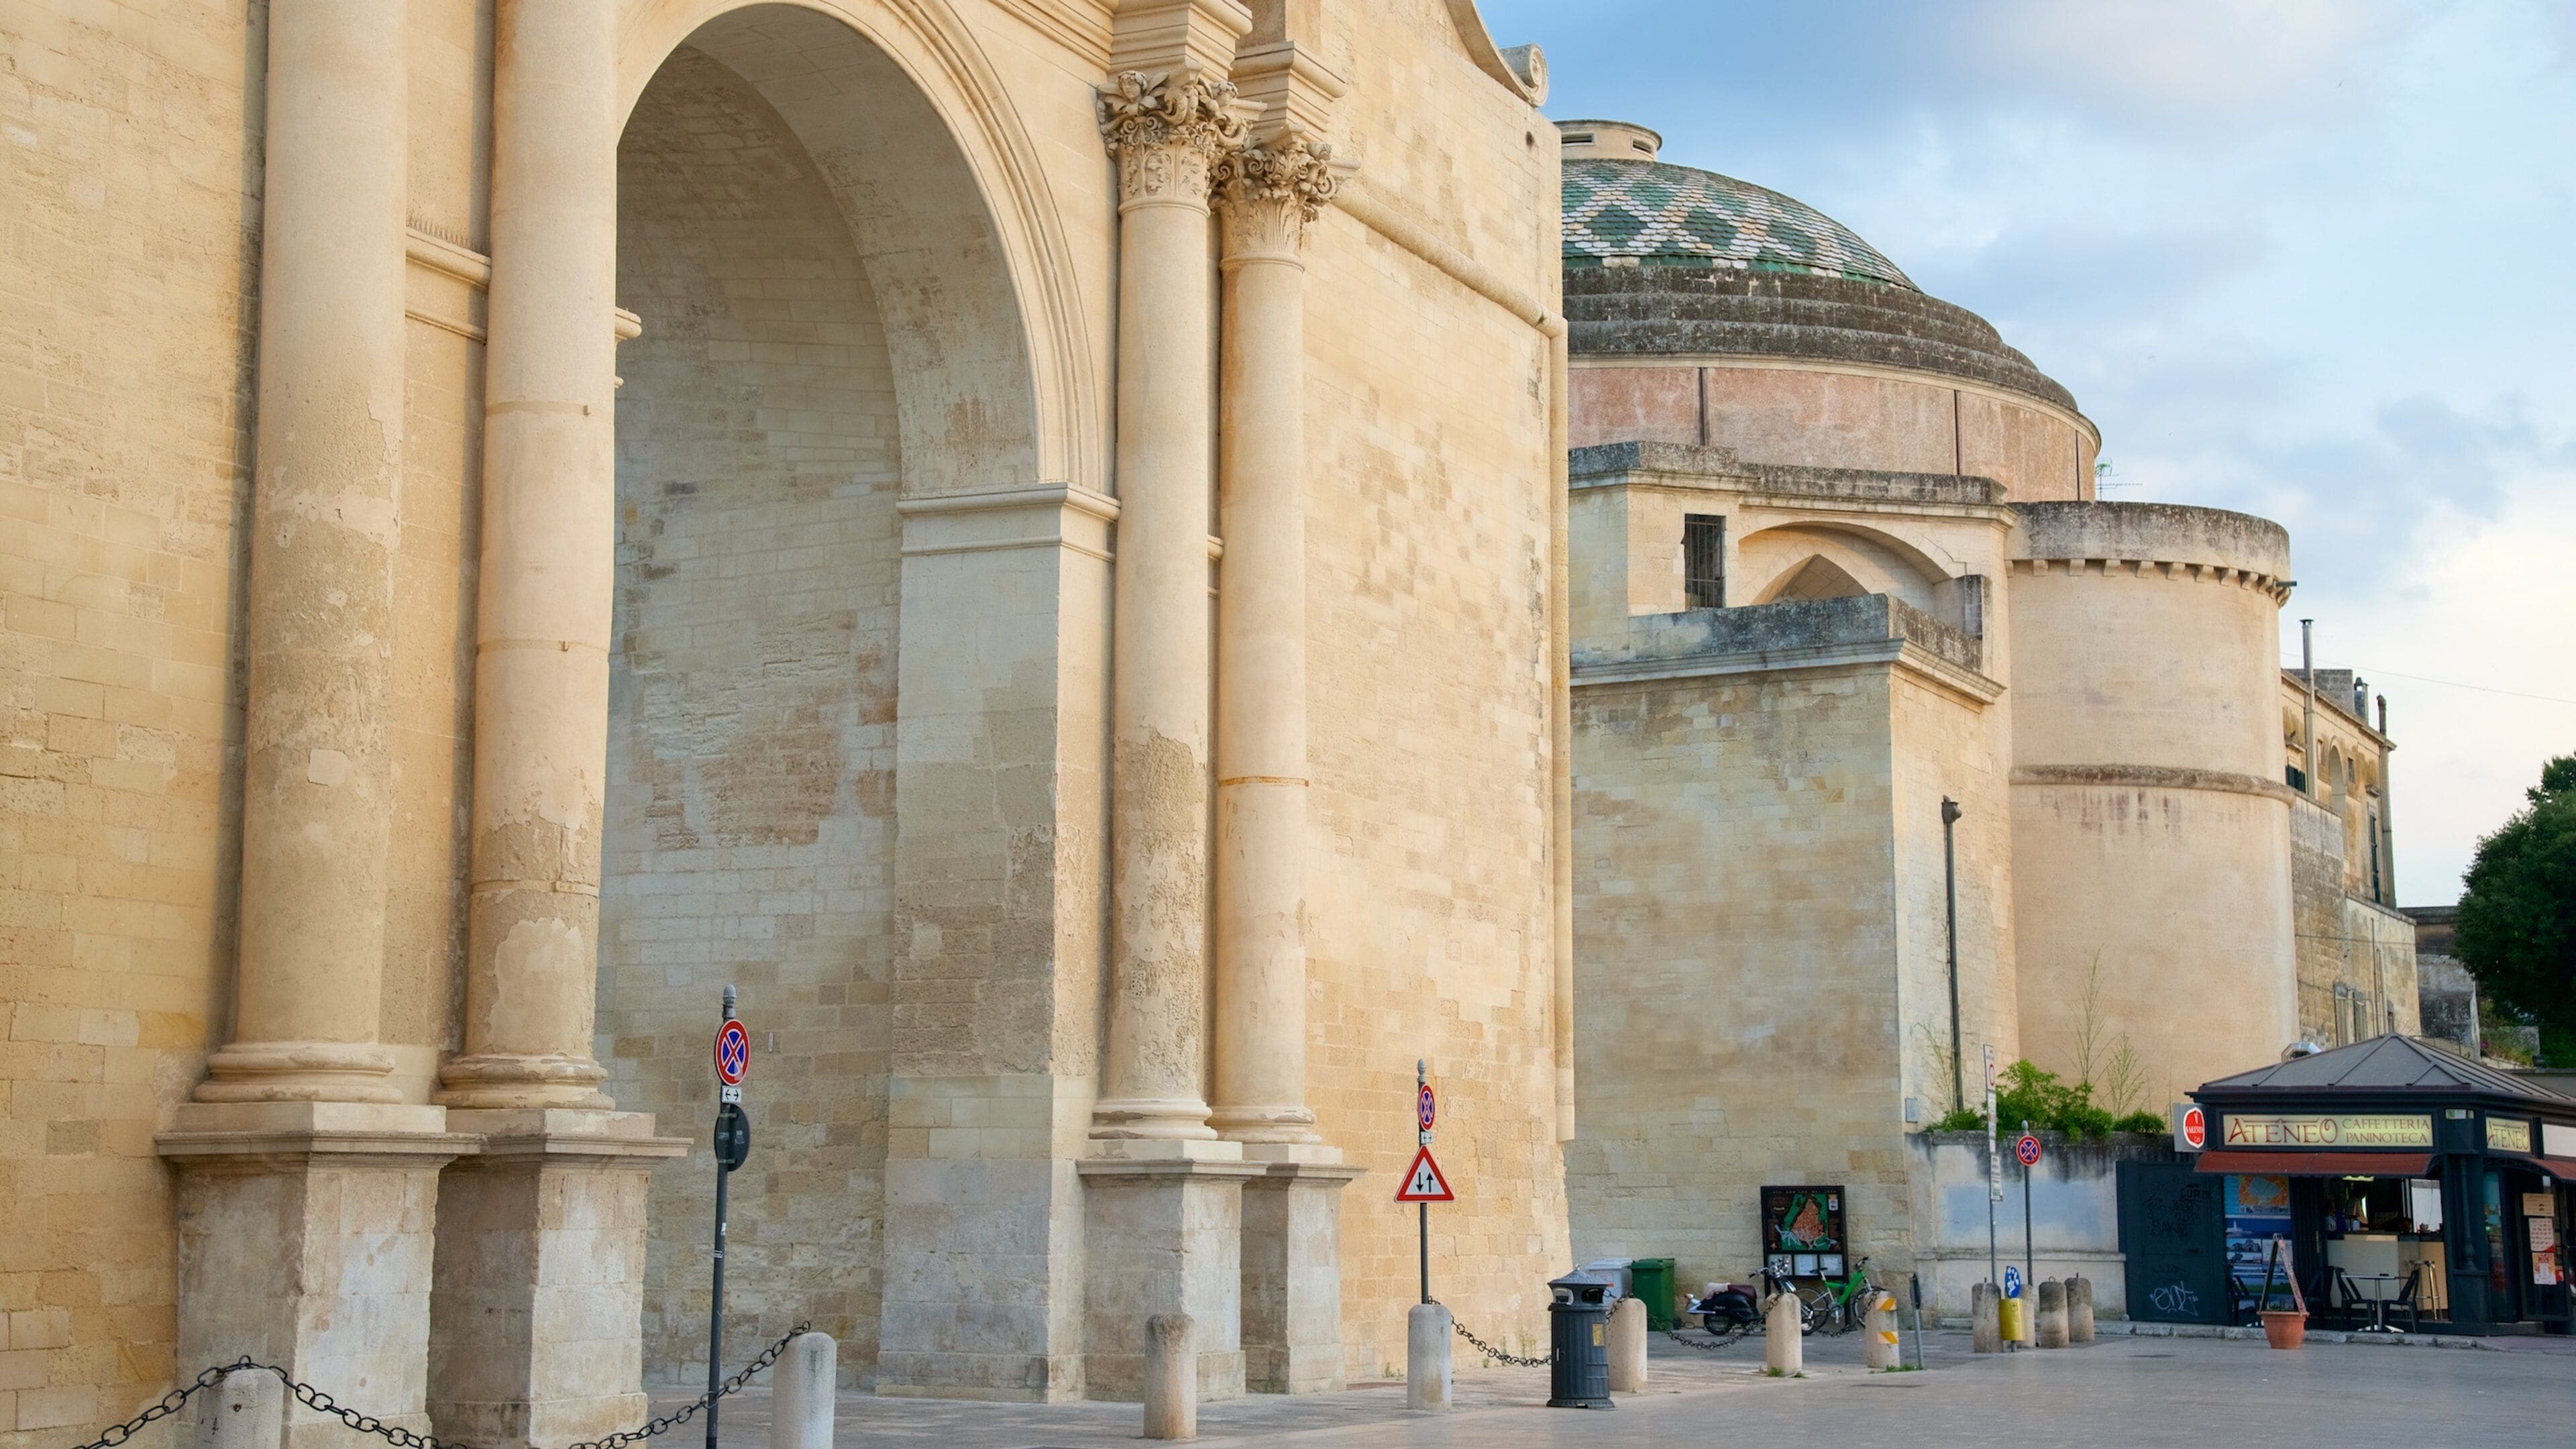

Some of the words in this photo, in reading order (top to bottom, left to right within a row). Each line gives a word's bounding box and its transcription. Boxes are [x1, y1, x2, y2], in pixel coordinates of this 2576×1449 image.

[2227, 1118, 2339, 1143] ATENEO
[2342, 1118, 2430, 1130] CAFFETTERIA
[2346, 1132, 2428, 1143] PANINOTECA
[2487, 1121, 2529, 1150] ATENEO
